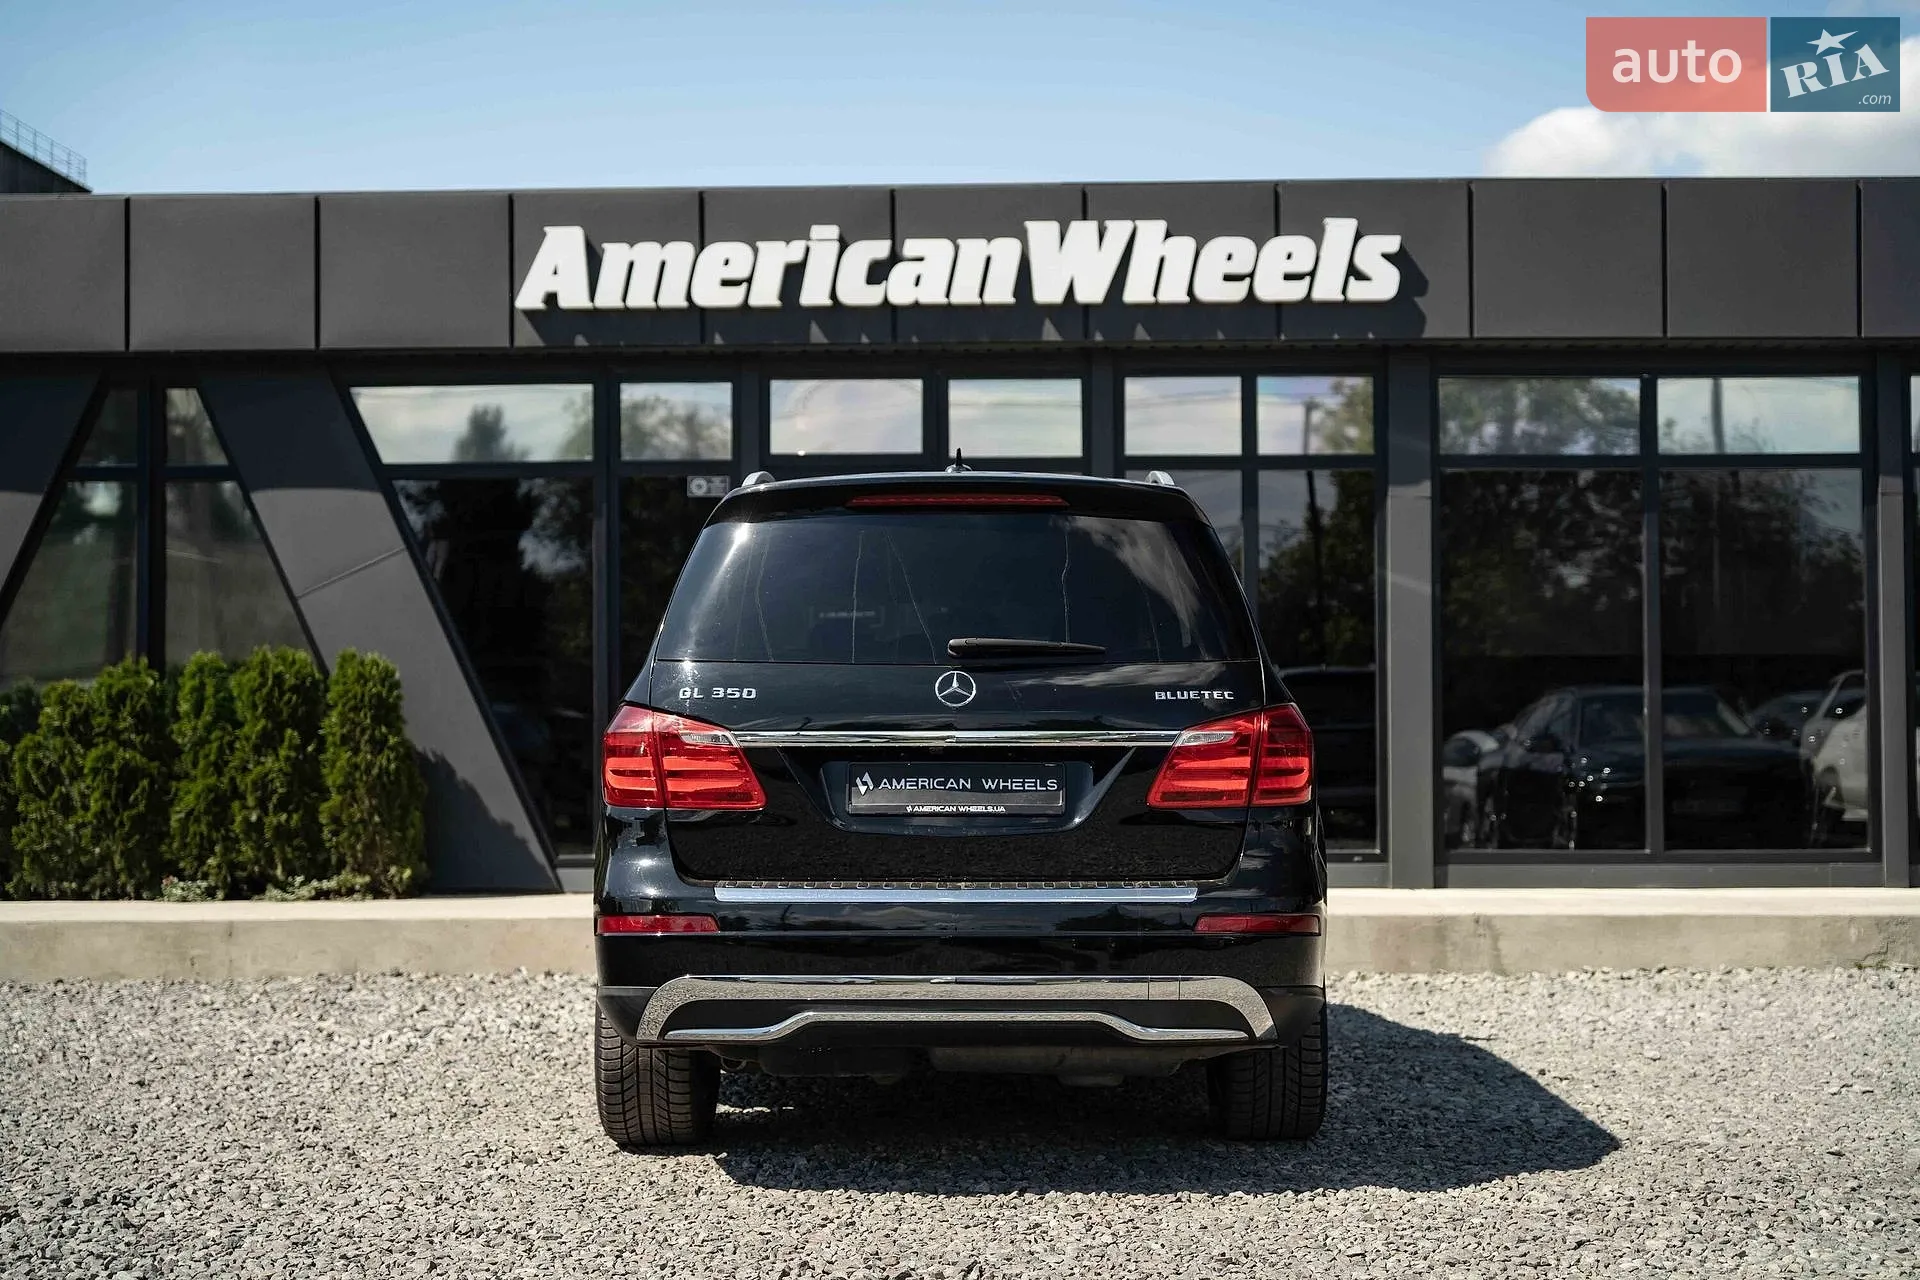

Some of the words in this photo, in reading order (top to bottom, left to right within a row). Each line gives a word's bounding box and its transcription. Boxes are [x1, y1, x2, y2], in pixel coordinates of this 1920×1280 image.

[515, 217, 1402, 310] AmericanWheels
[679, 686, 704, 699] GL
[711, 687, 757, 699] 350
[1155, 690, 1234, 700] BLUETEC
[878, 778, 971, 790] AMERICAN
[981, 778, 1058, 791] WHEELS
[912, 804, 957, 813] AMERICAN
[957, 804, 1006, 813] WHEELS.UA
